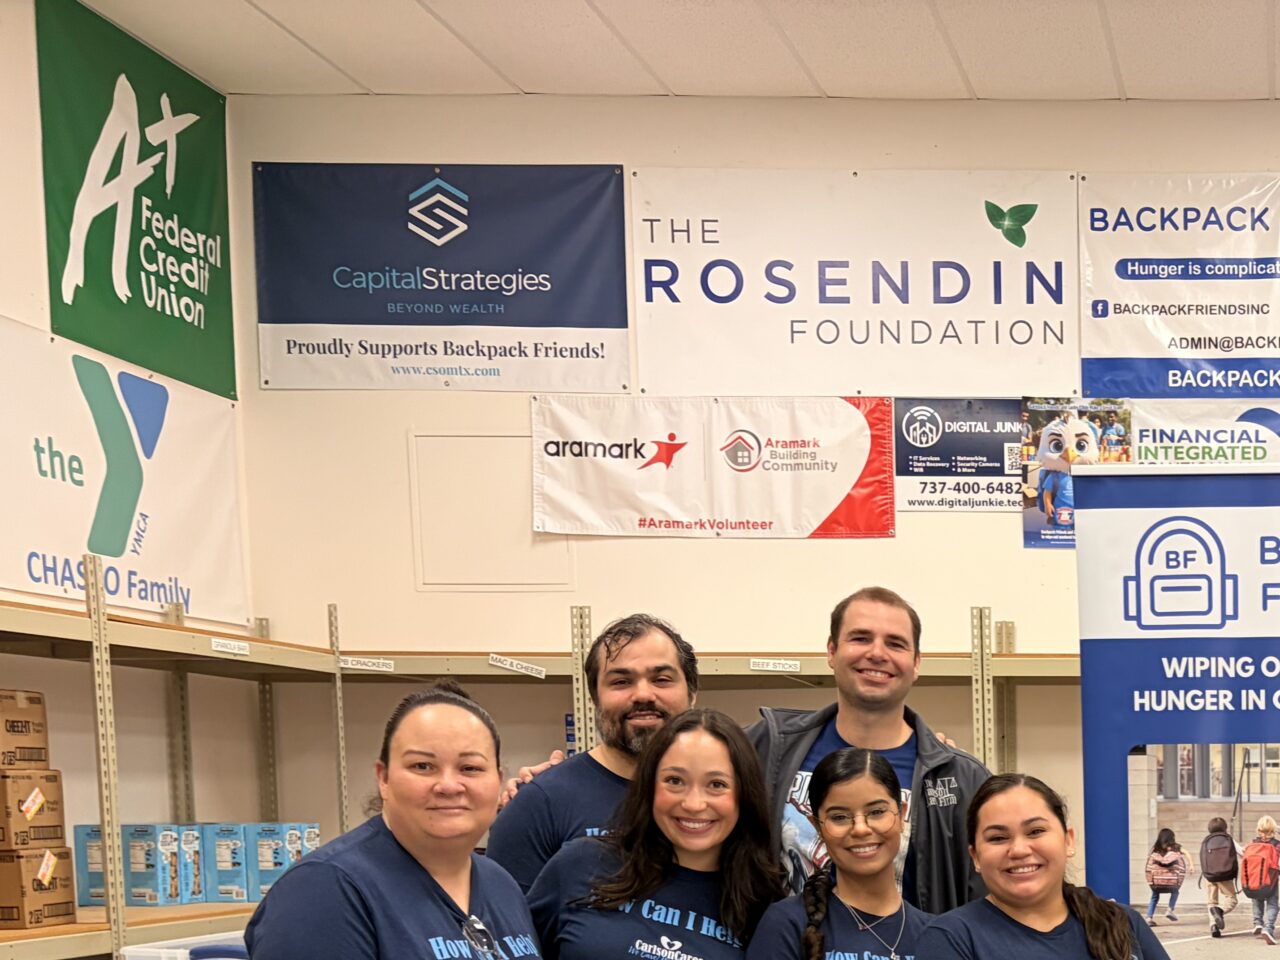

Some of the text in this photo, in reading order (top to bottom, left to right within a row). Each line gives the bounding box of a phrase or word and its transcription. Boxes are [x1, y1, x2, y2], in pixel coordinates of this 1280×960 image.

[1089, 206, 1270, 233] BACKPACK
[141, 196, 221, 269] Federal
[642, 218, 720, 244] THE
[139, 236, 209, 296] Credit
[1127, 261, 1183, 278] Hunger
[1188, 261, 1202, 276] is
[332, 266, 552, 296] CapitalStrategies
[643, 259, 1064, 305] ROSENDIN
[141, 275, 205, 330] Union
[387, 303, 505, 315] BEYOND WEALTH
[1113, 303, 1270, 316] BACKPACKFRIENDSINC
[790, 319, 1065, 345] FOUNDATION
[285, 338, 606, 360] Proudly Supports Backpack Friends!
[390, 365, 501, 378] www.csomtx.com
[945, 422, 991, 433] DIGITAL
[1138, 428, 1267, 444] FINANCIAL
[544, 438, 647, 460] aramark
[764, 437, 820, 450] Aramark
[1137, 446, 1267, 461] INTEGRATED
[33, 436, 85, 487] the
[762, 460, 838, 473] Community
[770, 450, 817, 461] Building
[919, 481, 1022, 494] 737-400-6482
[131, 511, 150, 557] YMCA
[638, 518, 774, 531] #AramarkVolunteer
[1165, 550, 1197, 570] BF
[27, 550, 191, 614] CHASO Family
[351, 659, 393, 669] CRACKERS
[490, 655, 508, 667] MAC
[515, 662, 545, 677] CHEESE
[752, 661, 799, 671] BEEF STICKS
[1161, 656, 1255, 679] WIPING
[1133, 689, 1234, 712] HUNGER
[1241, 689, 1266, 711] IN
[641, 899, 680, 926] Can
[685, 910, 697, 931] I
[428, 937, 472, 960] How
